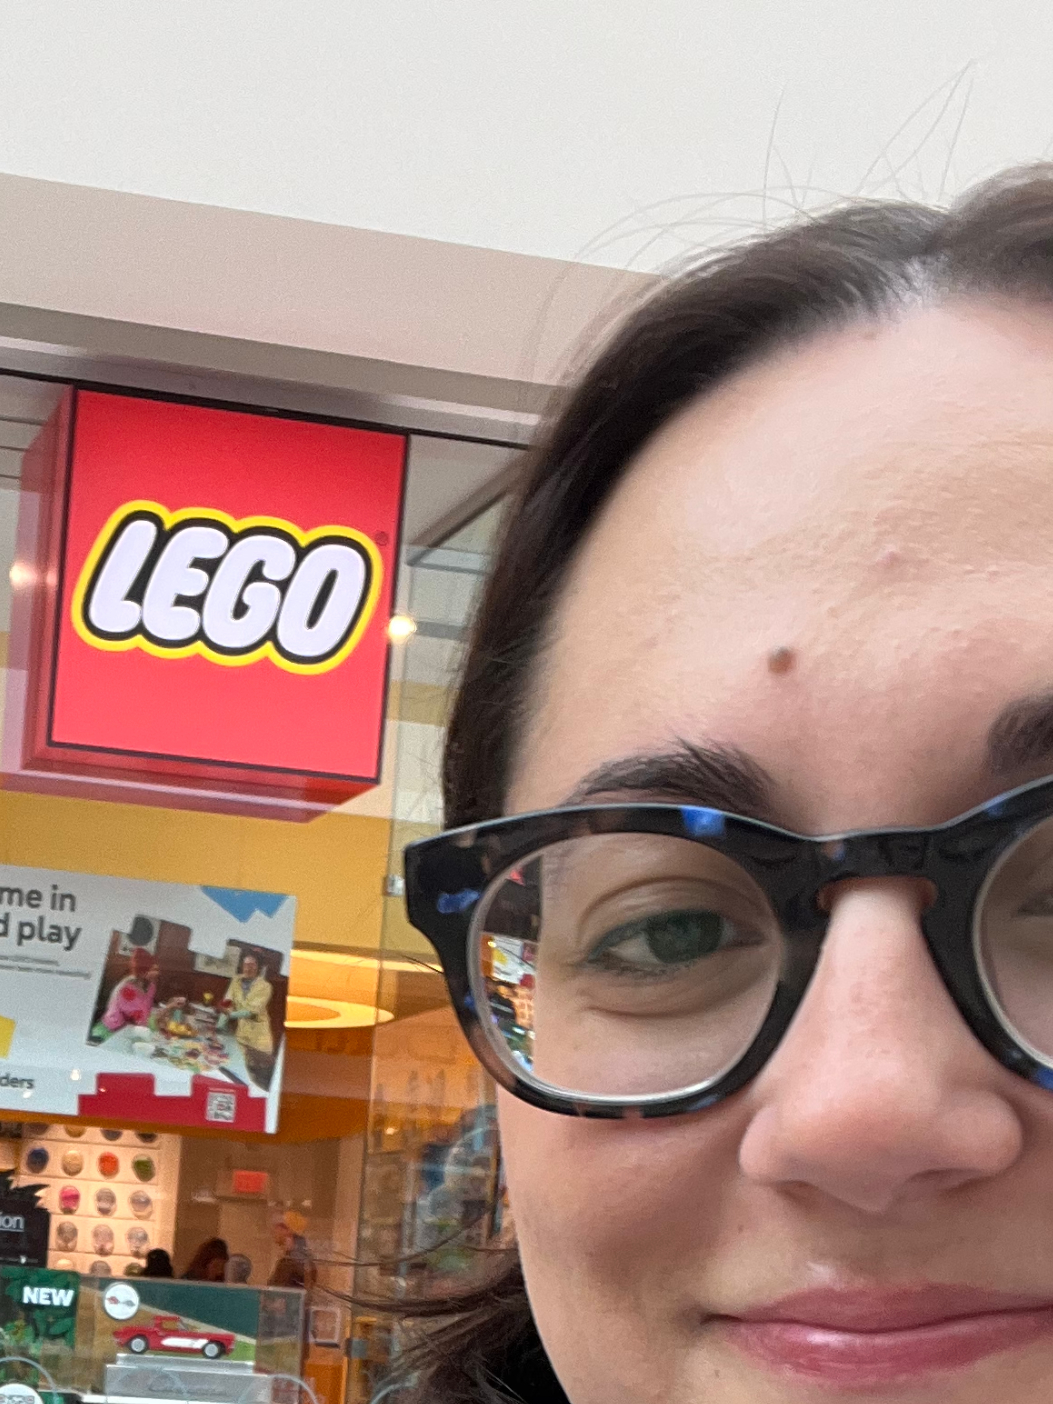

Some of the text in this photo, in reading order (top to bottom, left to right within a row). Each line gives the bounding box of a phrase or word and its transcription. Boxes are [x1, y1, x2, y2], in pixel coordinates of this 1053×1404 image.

[83, 511, 374, 664] LEGO
[50, 884, 76, 912] in
[16, 915, 82, 951] play
[23, 1286, 75, 1307] NEW
